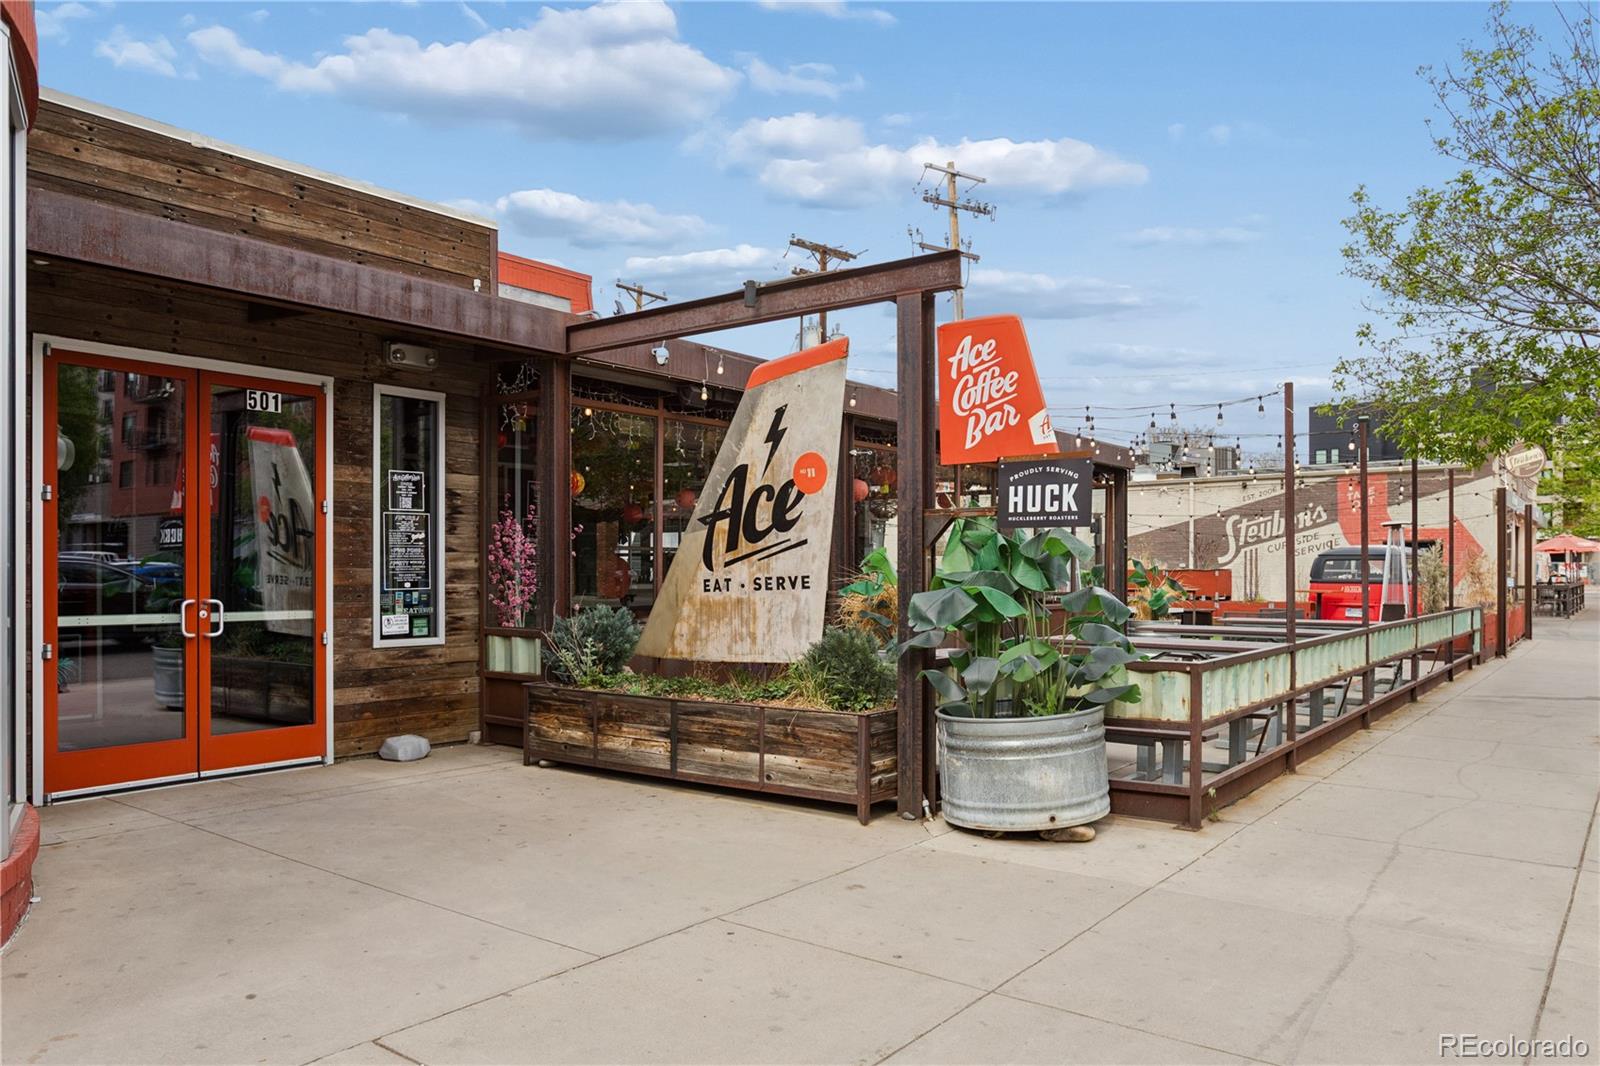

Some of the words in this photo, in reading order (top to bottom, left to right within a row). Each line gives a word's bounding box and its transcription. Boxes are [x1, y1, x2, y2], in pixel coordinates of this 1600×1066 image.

[947, 335, 998, 379] Ace
[248, 392, 279, 412] 501
[952, 365, 1019, 417] Coffee
[965, 403, 1021, 450] Bar
[1009, 466, 1043, 482] PROUDLY
[1046, 466, 1079, 480] SERVING
[1008, 483, 1079, 513] HUCK
[1346, 486, 1376, 501] TAE
[1352, 495, 1376, 508] OT
[696, 463, 807, 572] Ace
[1217, 502, 1328, 564] Steubn's
[1294, 537, 1341, 557] SERVICE
[703, 578, 731, 592] EAT
[753, 575, 811, 591] SERVE
